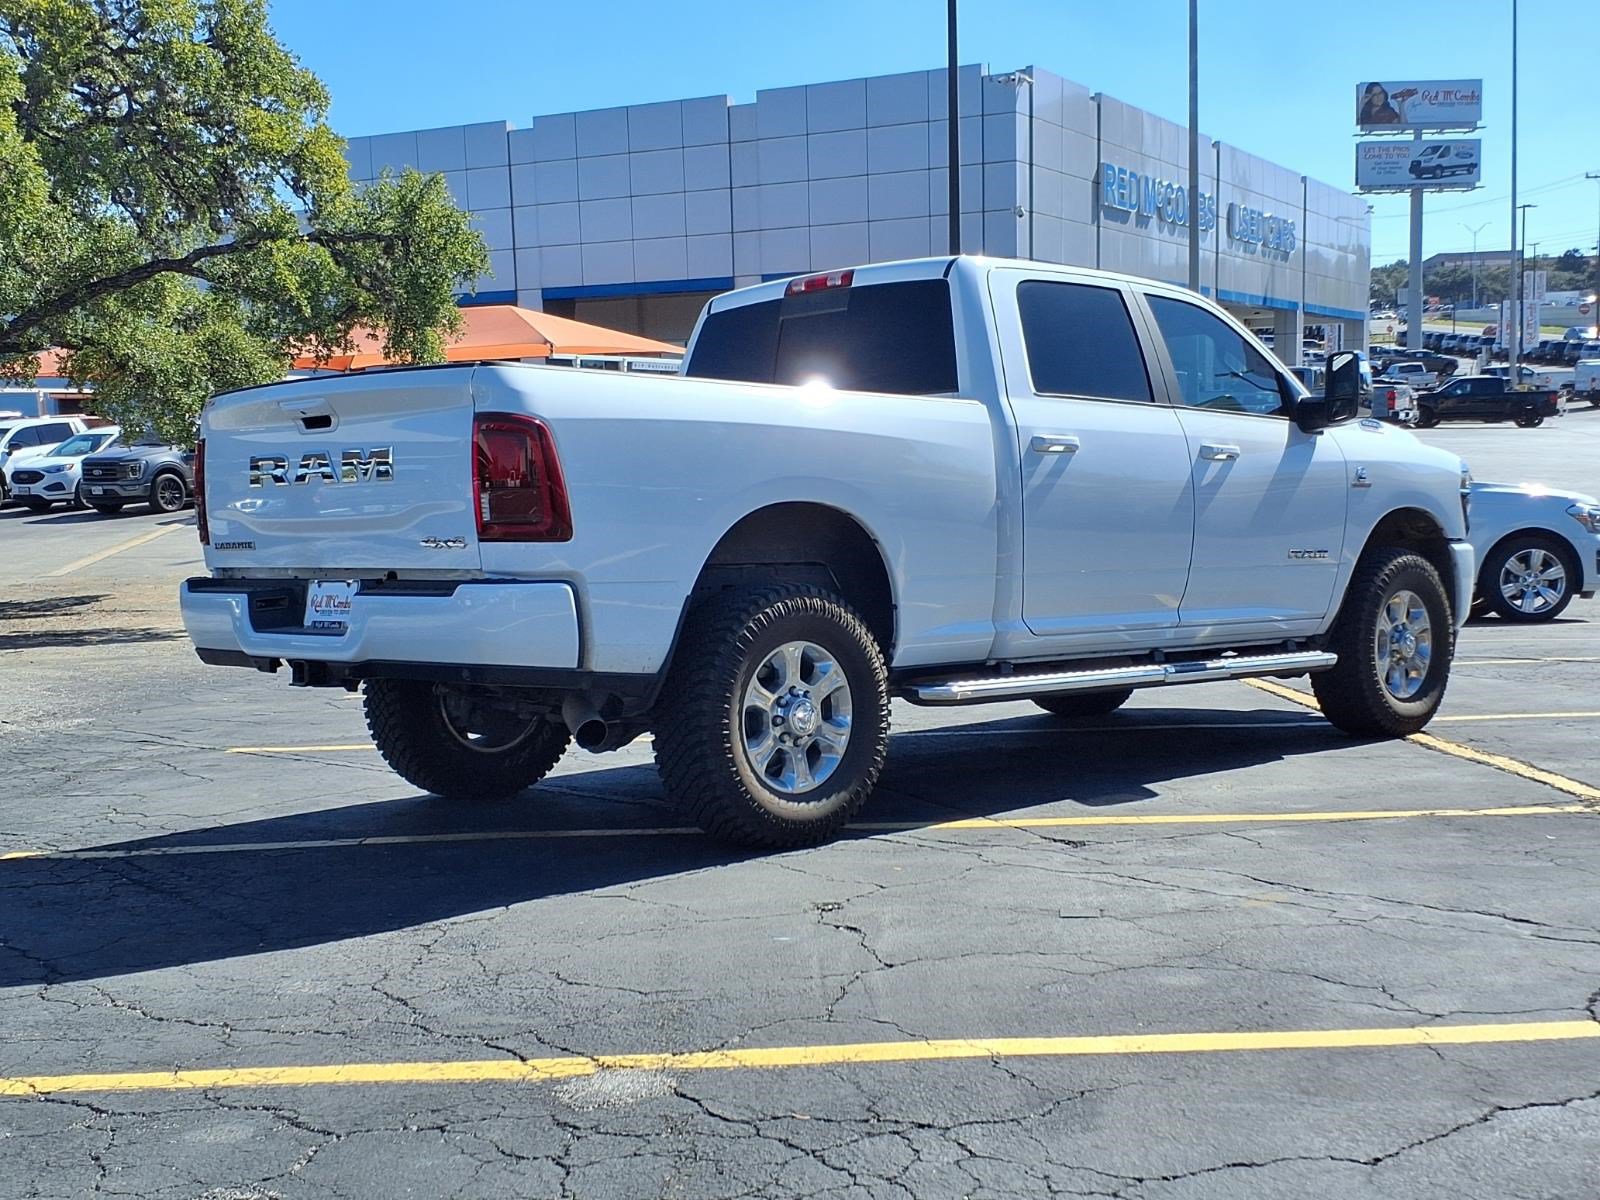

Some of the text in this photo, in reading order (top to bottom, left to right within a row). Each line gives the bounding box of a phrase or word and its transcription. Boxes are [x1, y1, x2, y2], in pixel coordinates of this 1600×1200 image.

[1421, 89, 1439, 106] Red
[1102, 162, 1138, 212] RED
[1229, 202, 1264, 244] USED
[249, 446, 393, 488] RAM
[311, 593, 324, 613] Red
